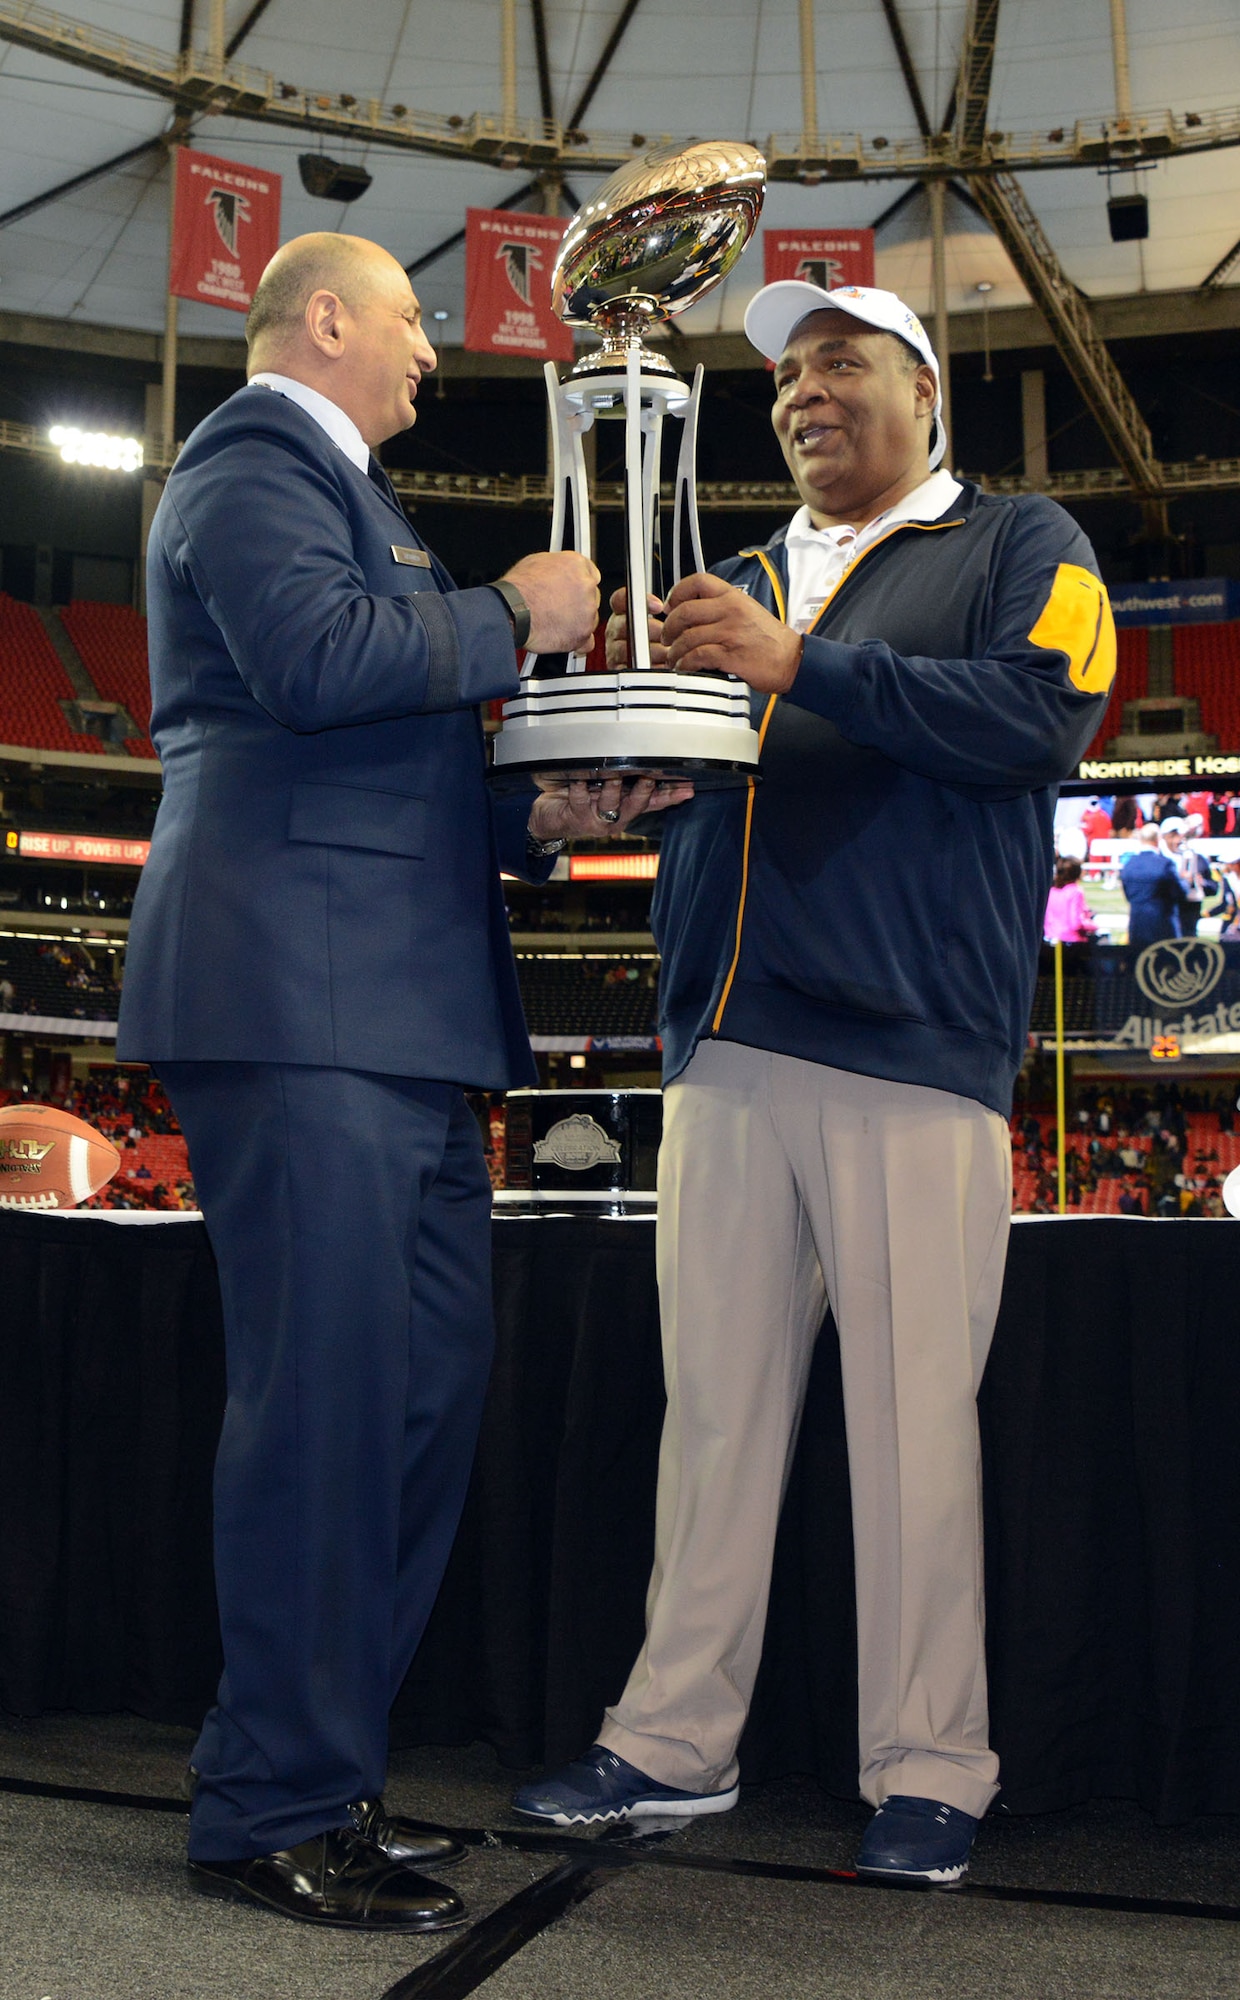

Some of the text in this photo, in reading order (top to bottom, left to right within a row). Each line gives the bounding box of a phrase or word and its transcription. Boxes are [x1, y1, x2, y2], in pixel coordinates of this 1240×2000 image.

[190, 164, 269, 194] FALCONS
[480, 222, 560, 240] FALCONS
[778, 241, 861, 251] FALCONS
[491, 333, 547, 349] CHAMPIONS
[1110, 594, 1223, 612] outhwest.com
[1195, 756, 1240, 774] HOS
[20, 836, 49, 853] RISE
[51, 838, 72, 855] UP.
[74, 840, 122, 858] POWER
[124, 845, 144, 860] UP.
[1113, 1002, 1240, 1050] Allstate
[1151, 1035, 1180, 1058] 25
[0, 1161, 41, 1175] SPALDIN
